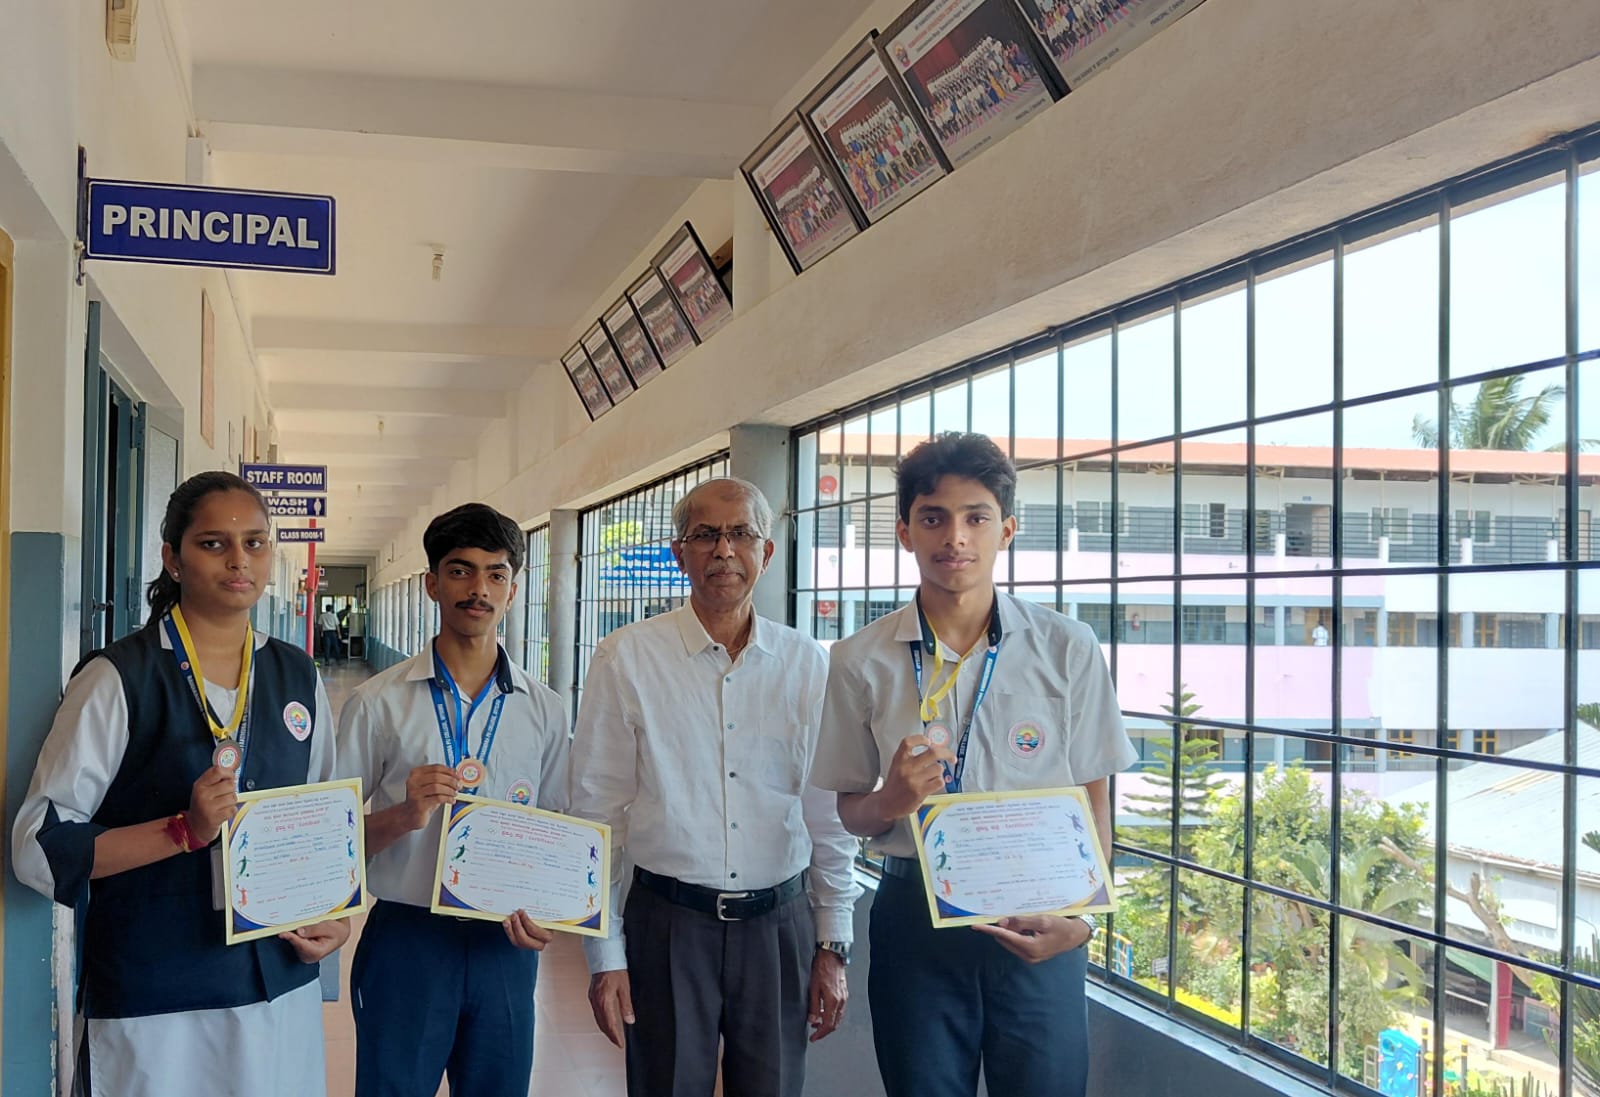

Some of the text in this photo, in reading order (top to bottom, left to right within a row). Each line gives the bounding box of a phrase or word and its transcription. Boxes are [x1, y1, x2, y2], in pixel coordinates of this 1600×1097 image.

[102, 204, 319, 249] PRINCIPAL
[246, 470, 323, 485] STAFF ROOM
[267, 497, 307, 506] WASH
[268, 506, 308, 515] ROOM
[280, 531, 299, 540] CLASS
